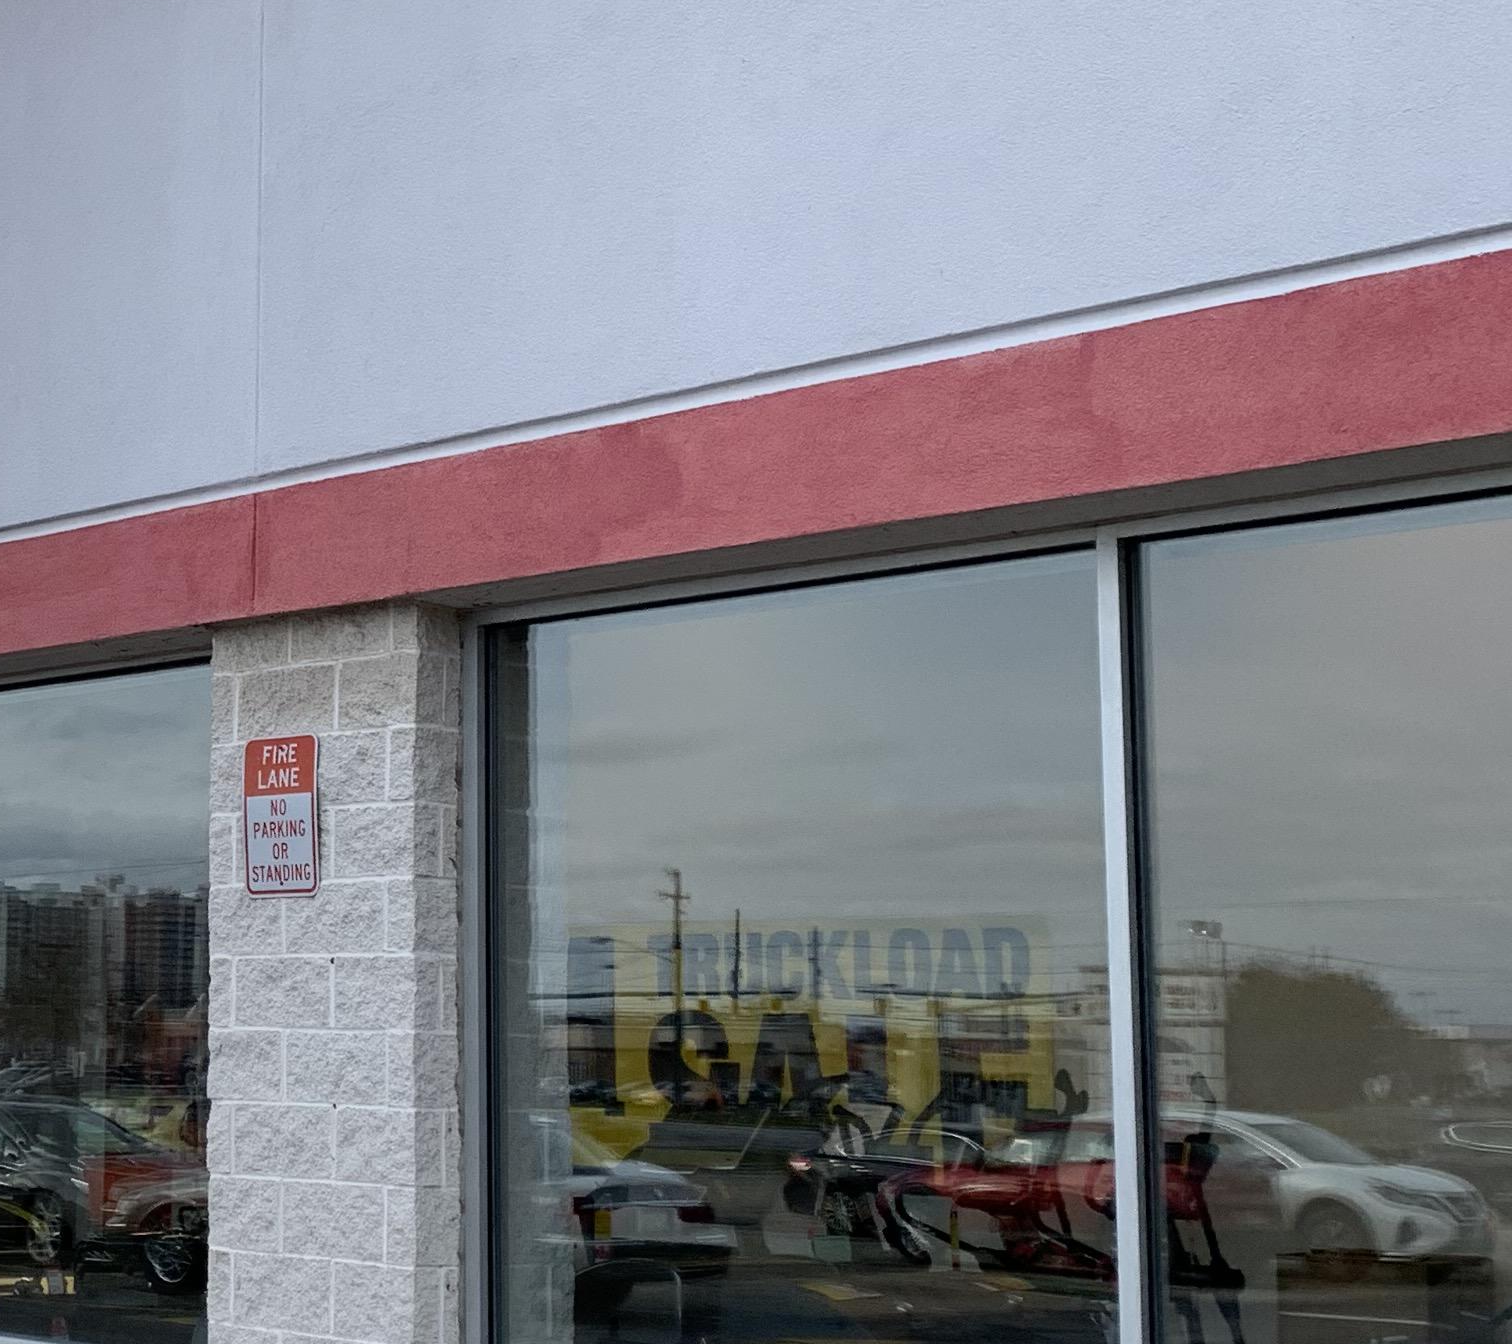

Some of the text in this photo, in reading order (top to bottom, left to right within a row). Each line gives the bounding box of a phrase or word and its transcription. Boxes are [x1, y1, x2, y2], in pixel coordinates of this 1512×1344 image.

[262, 743, 298, 765] FIRE
[257, 767, 300, 790] LANE
[270, 798, 287, 817] NO
[253, 819, 306, 840] PARKING
[272, 842, 289, 860] OR
[252, 863, 311, 883] STANDING
[647, 926, 1031, 1001] TRUCKLOAD
